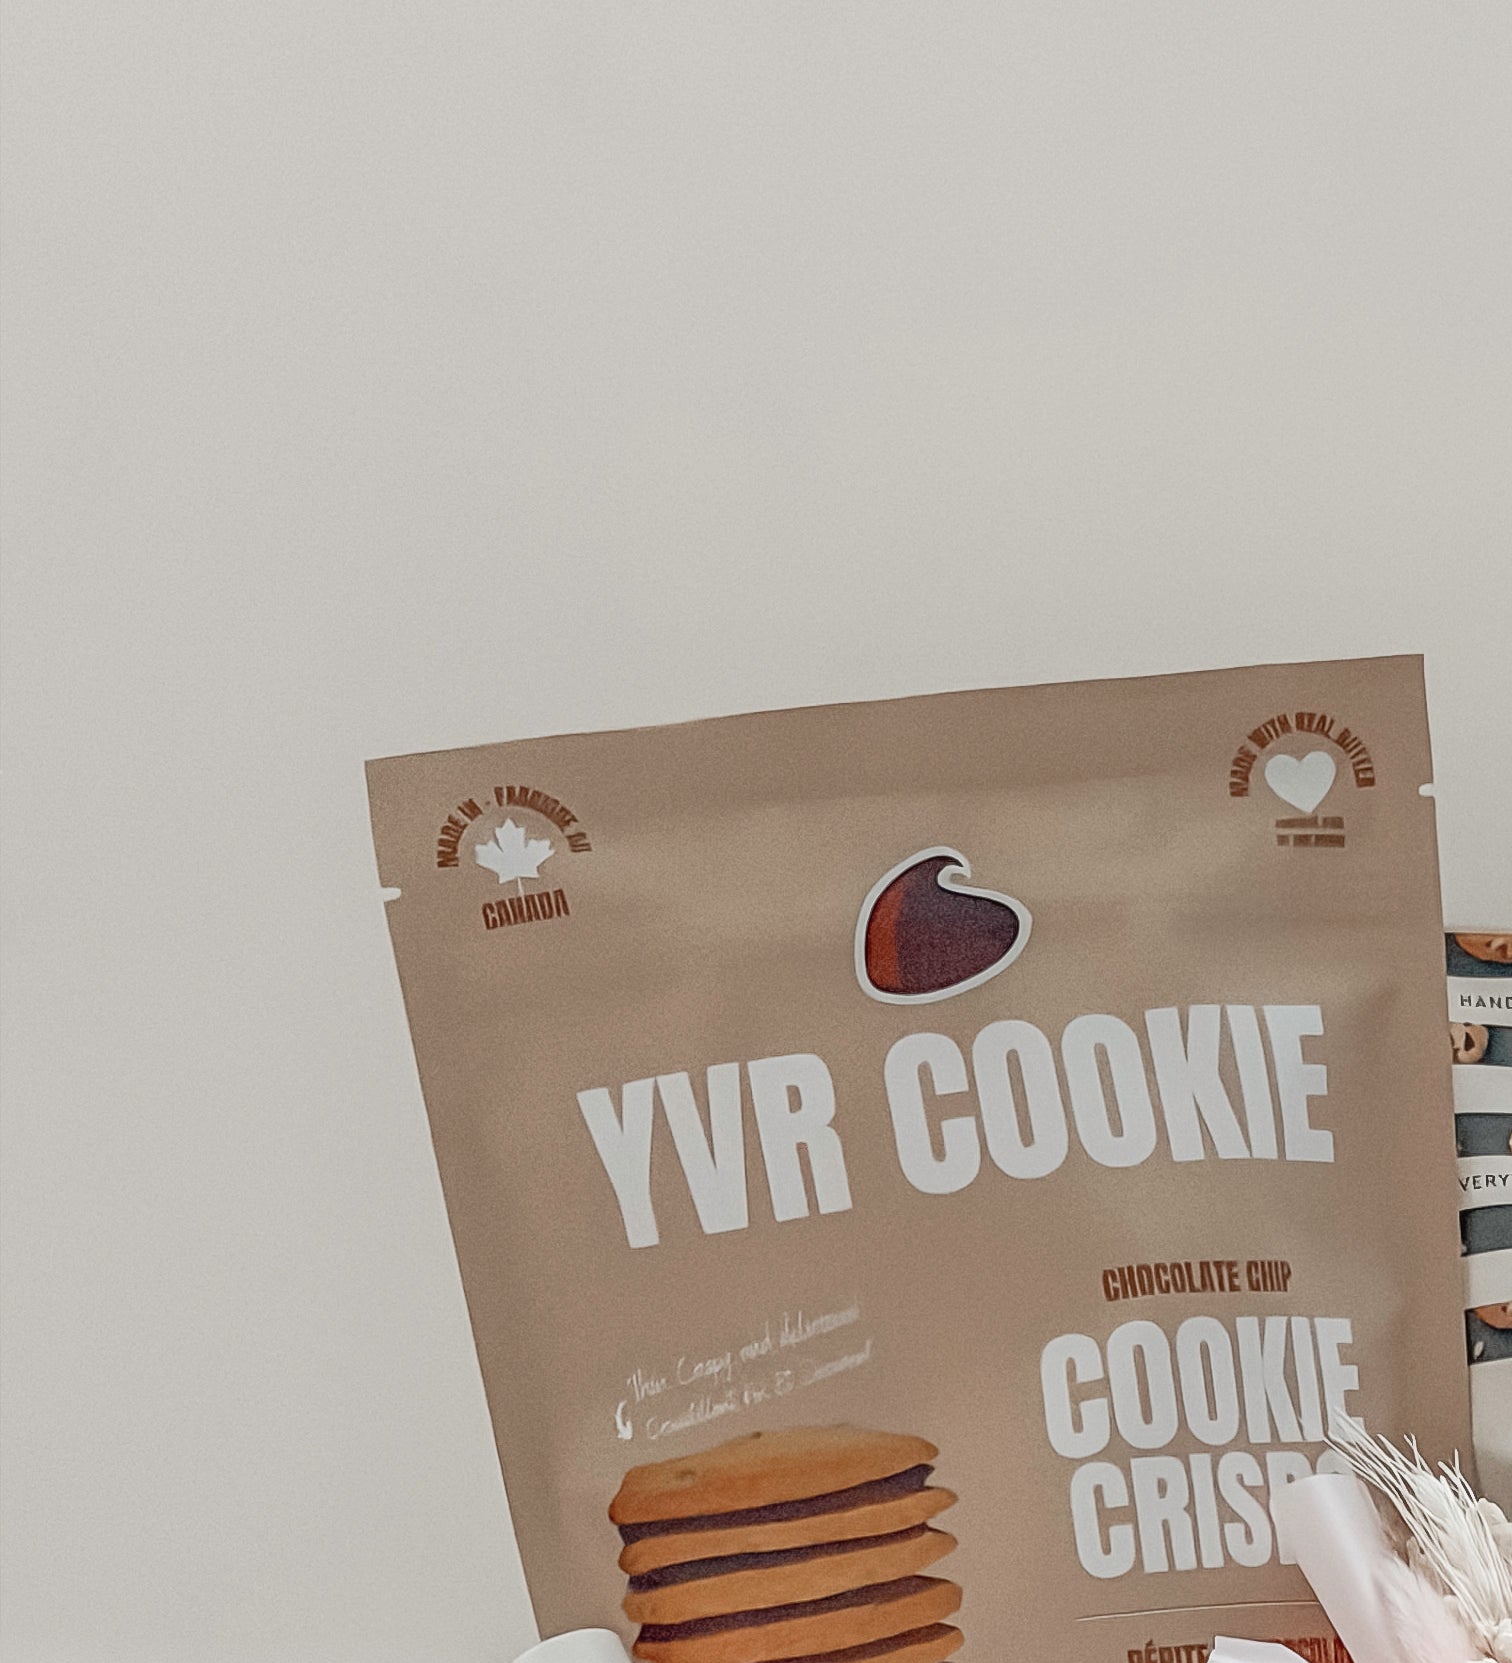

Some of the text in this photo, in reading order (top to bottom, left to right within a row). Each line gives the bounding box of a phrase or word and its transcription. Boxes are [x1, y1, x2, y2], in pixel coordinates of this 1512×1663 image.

[437, 813, 469, 868] MADE
[457, 798, 484, 821] IN
[481, 888, 570, 930] CANADA
[576, 1004, 1335, 1249] YVR COOKIE
[1102, 1259, 1292, 1302] CHOCOLATE CHIP
[1040, 1315, 1366, 1459] COOKIE
